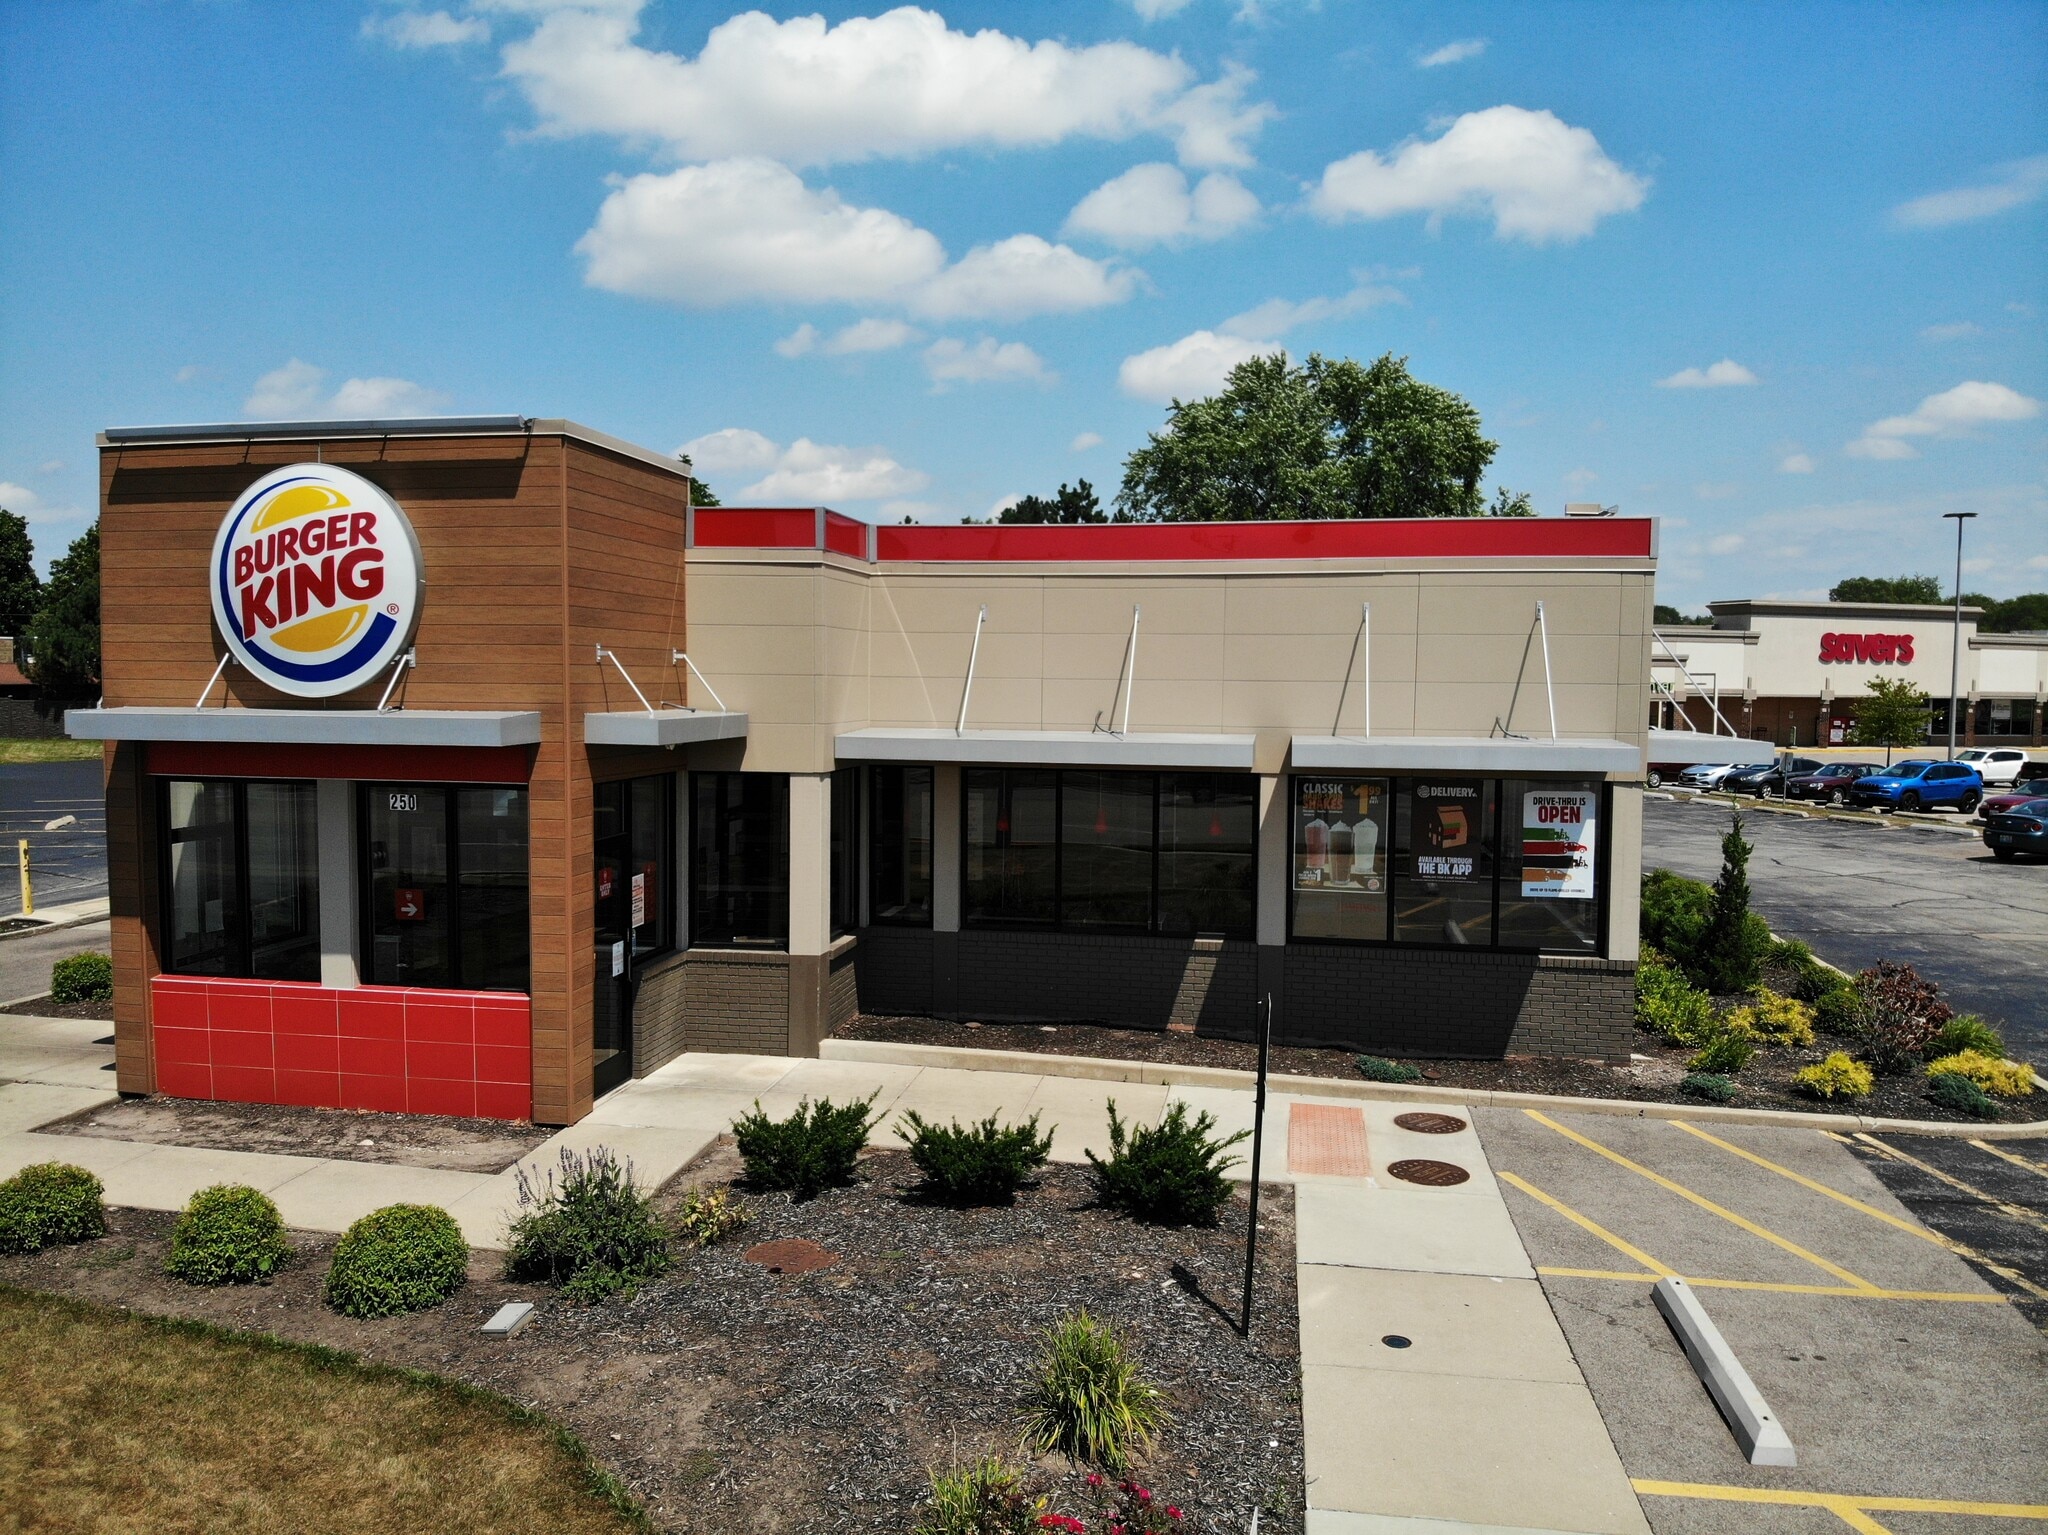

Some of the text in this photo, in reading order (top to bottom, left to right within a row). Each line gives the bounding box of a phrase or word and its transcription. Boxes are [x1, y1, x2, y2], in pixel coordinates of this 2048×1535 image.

[235, 512, 377, 588] BURGER
[241, 548, 384, 640] KING
[1303, 783, 1343, 794] CLASSIC
[391, 794, 415, 810] 250
[1303, 799, 1344, 809] SHAKES
[1533, 797, 1586, 806] DRIVE-THRU IS
[1538, 806, 1580, 823] OPEN
[1418, 863, 1472, 875] THE BK APP
